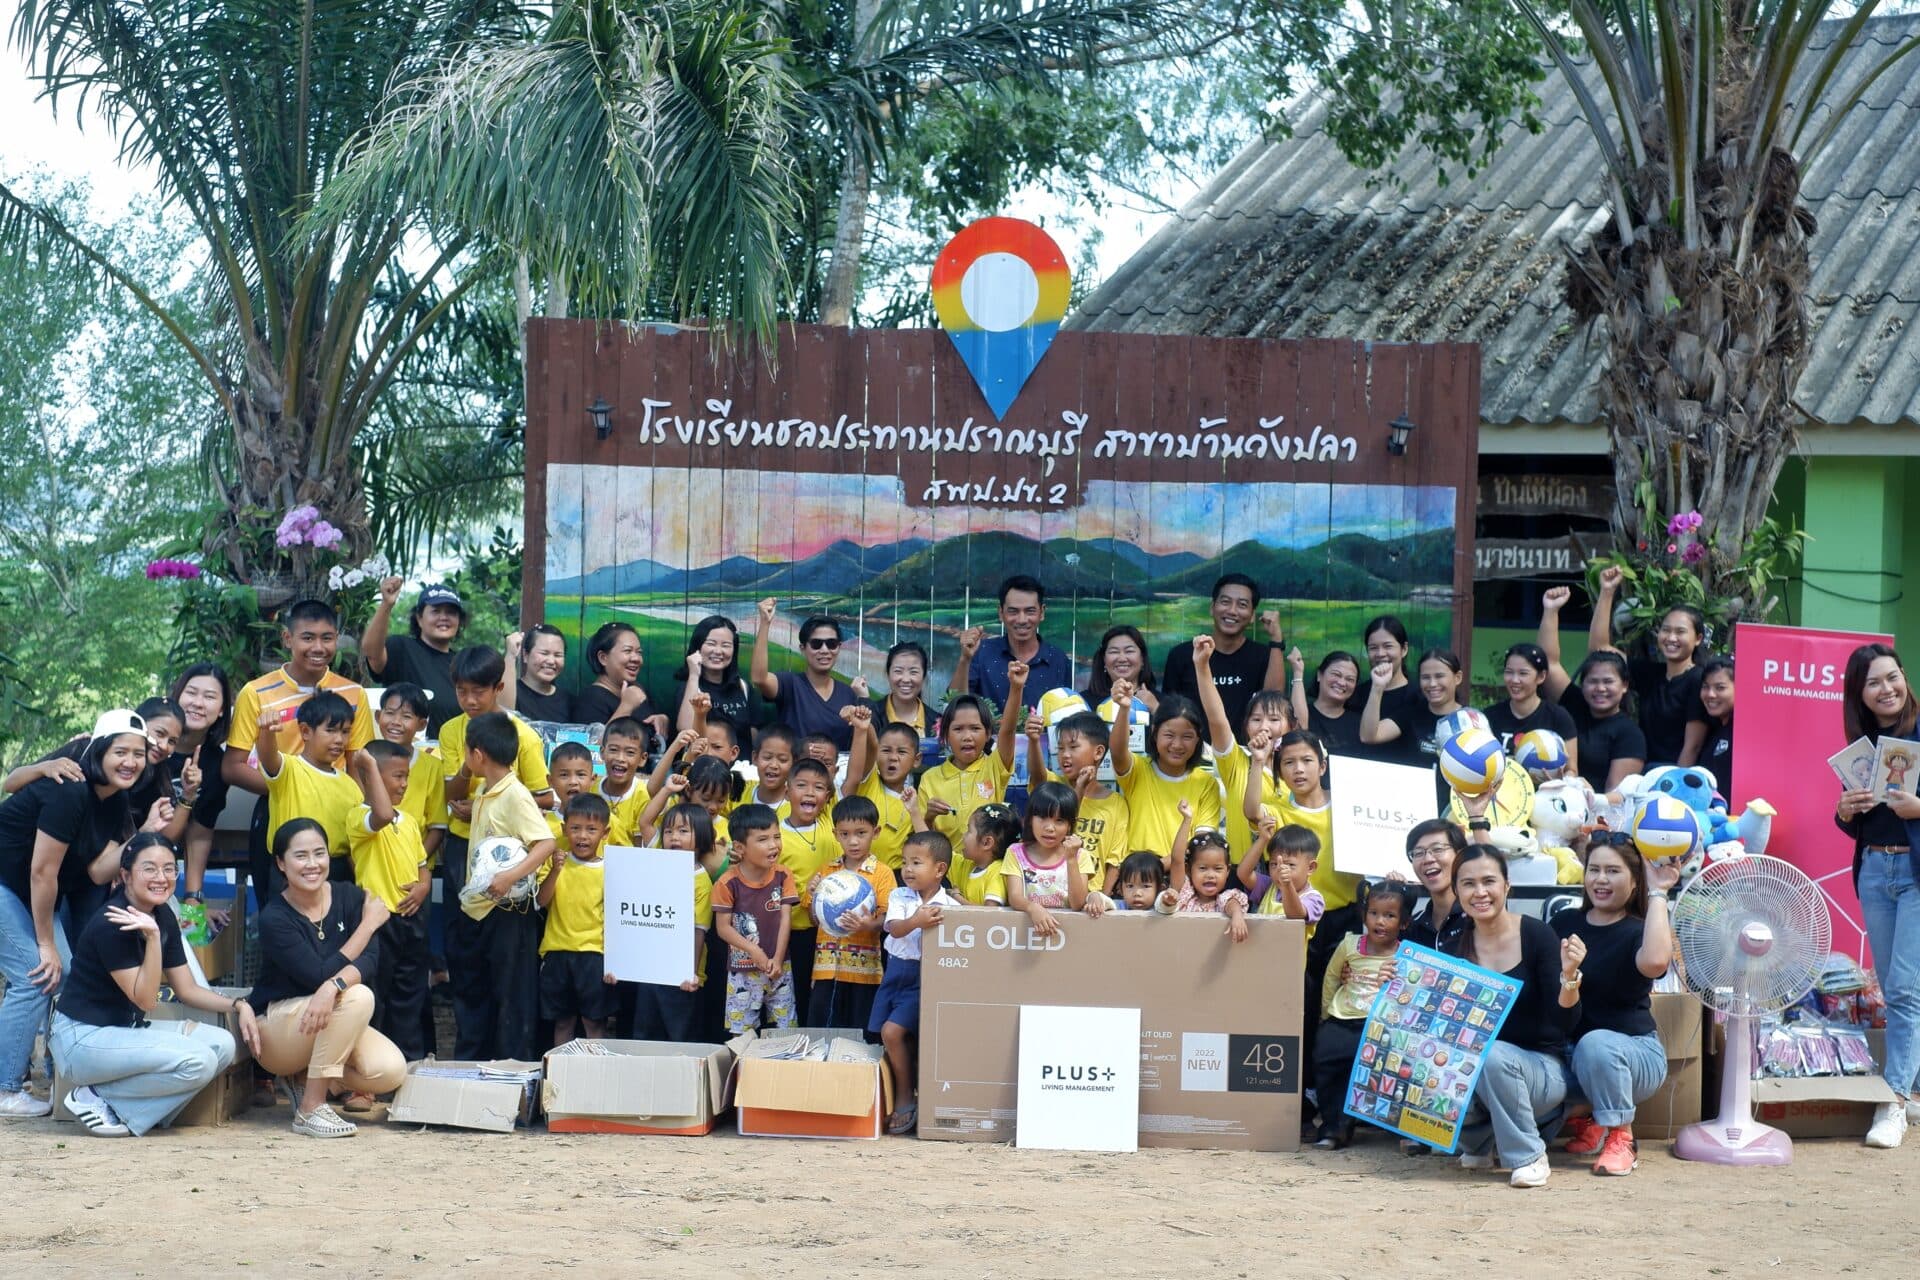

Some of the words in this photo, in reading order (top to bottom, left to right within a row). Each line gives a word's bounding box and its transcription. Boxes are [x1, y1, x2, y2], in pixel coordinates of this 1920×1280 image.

[639, 398, 1088, 476] โรงเรียนชลประทานปราณบุรี
[1094, 415, 1358, 462] สาขาบ้านวังปลา
[1763, 659, 1845, 686] PLUS
[1763, 685, 1792, 696] LIVING
[638, 921, 675, 929] MANAGEMENT
[938, 924, 976, 949] LG
[986, 925, 1066, 951] OLED
[938, 957, 969, 968] 48A2
[1153, 1031, 1173, 1039] OLED
[1194, 1049, 1216, 1057] 2022
[1243, 1043, 1285, 1073] 48
[1187, 1059, 1221, 1071] NEW
[1065, 1084, 1115, 1092] MANAGEMENT
